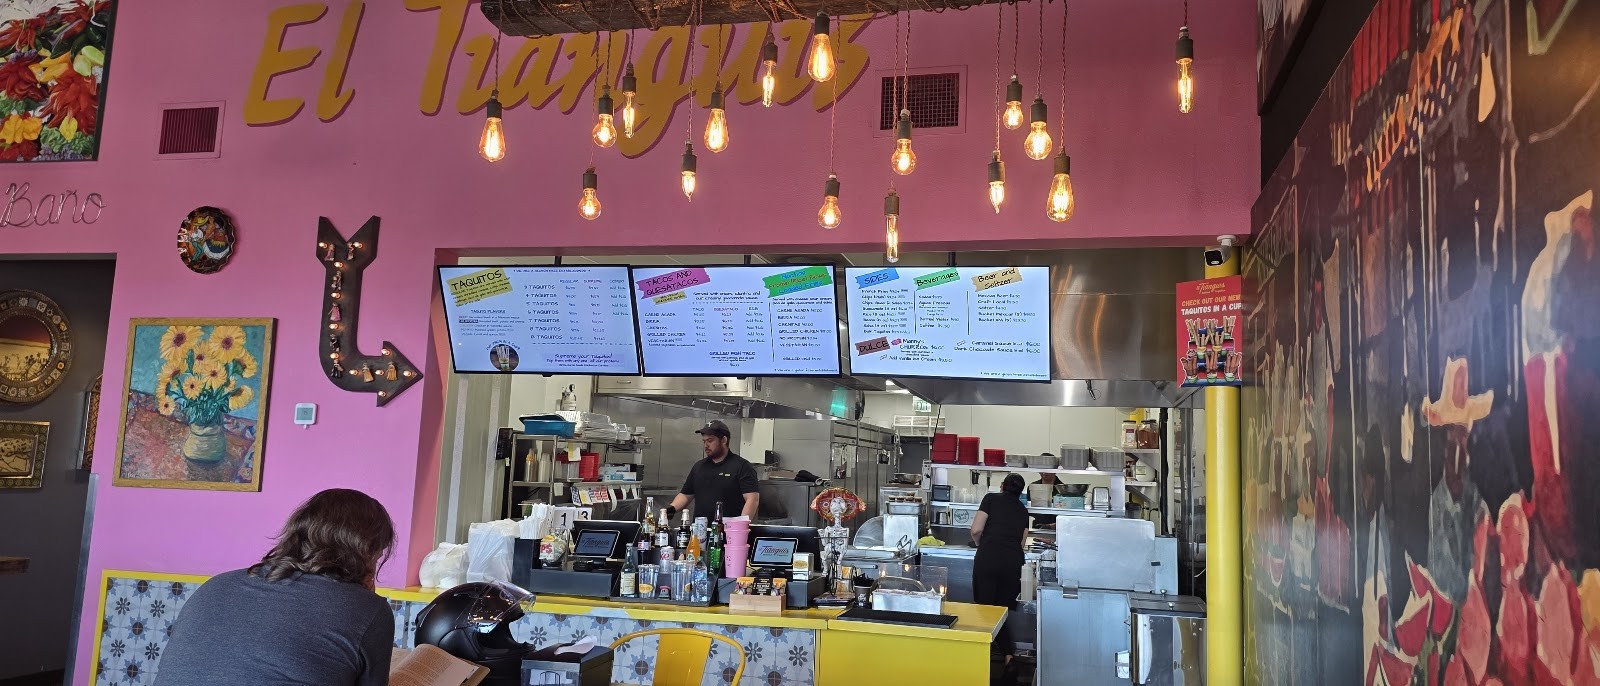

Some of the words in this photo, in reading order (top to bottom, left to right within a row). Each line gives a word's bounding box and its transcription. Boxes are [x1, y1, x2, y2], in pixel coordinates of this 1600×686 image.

[242, 2, 367, 127] El
[401, 0, 871, 157] Tianguis
[451, 270, 502, 291] TAQUITOS
[646, 275, 673, 287] TACOS
[676, 270, 692, 279] AND
[864, 273, 888, 285] SIDES
[916, 271, 959, 287] Beverages
[978, 272, 997, 283] Beer
[1002, 268, 1016, 277] and
[646, 278, 699, 295] QUESATACOS
[984, 278, 1012, 289] Seltzer
[1181, 306, 1211, 316] TAQUITOS
[1213, 304, 1220, 312] IN
[1222, 304, 1227, 312] A
[859, 341, 888, 353] DULCE
[561, 512, 567, 527] 1
